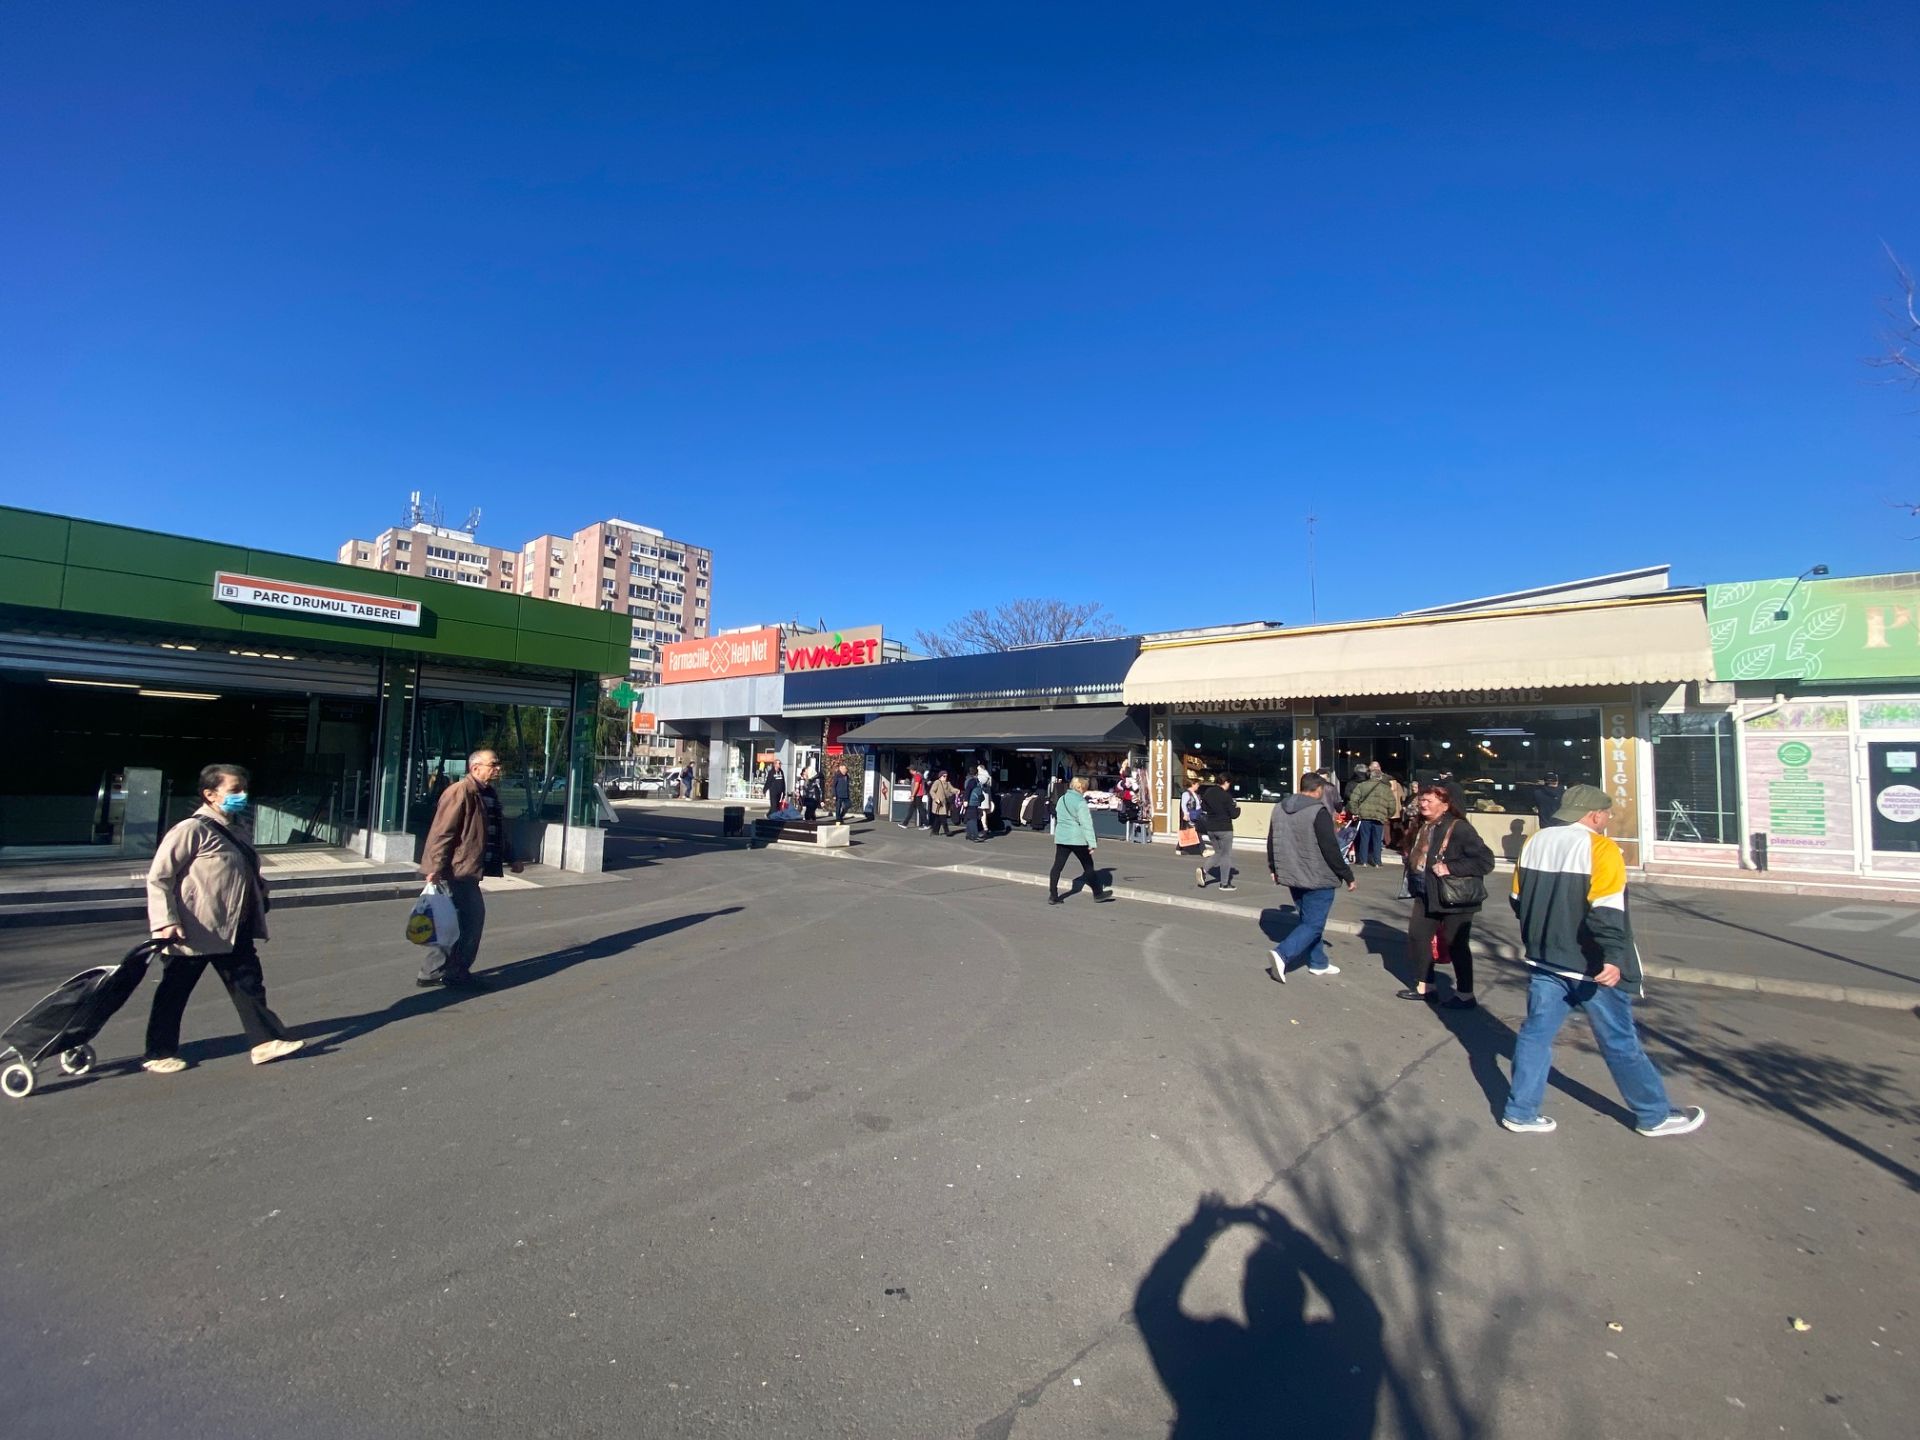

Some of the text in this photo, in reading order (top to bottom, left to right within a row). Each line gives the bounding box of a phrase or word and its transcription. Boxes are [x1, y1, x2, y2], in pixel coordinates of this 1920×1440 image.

[253, 590, 400, 620] PARC DRUMUL TABEREI
[1861, 606, 1920, 648] P
[669, 638, 768, 671] Farmaciile Help Net
[1174, 699, 1287, 713] PANIFICATIE
[1416, 688, 1543, 706] PATISERIE
[1155, 722, 1165, 810] PANIFICATIE
